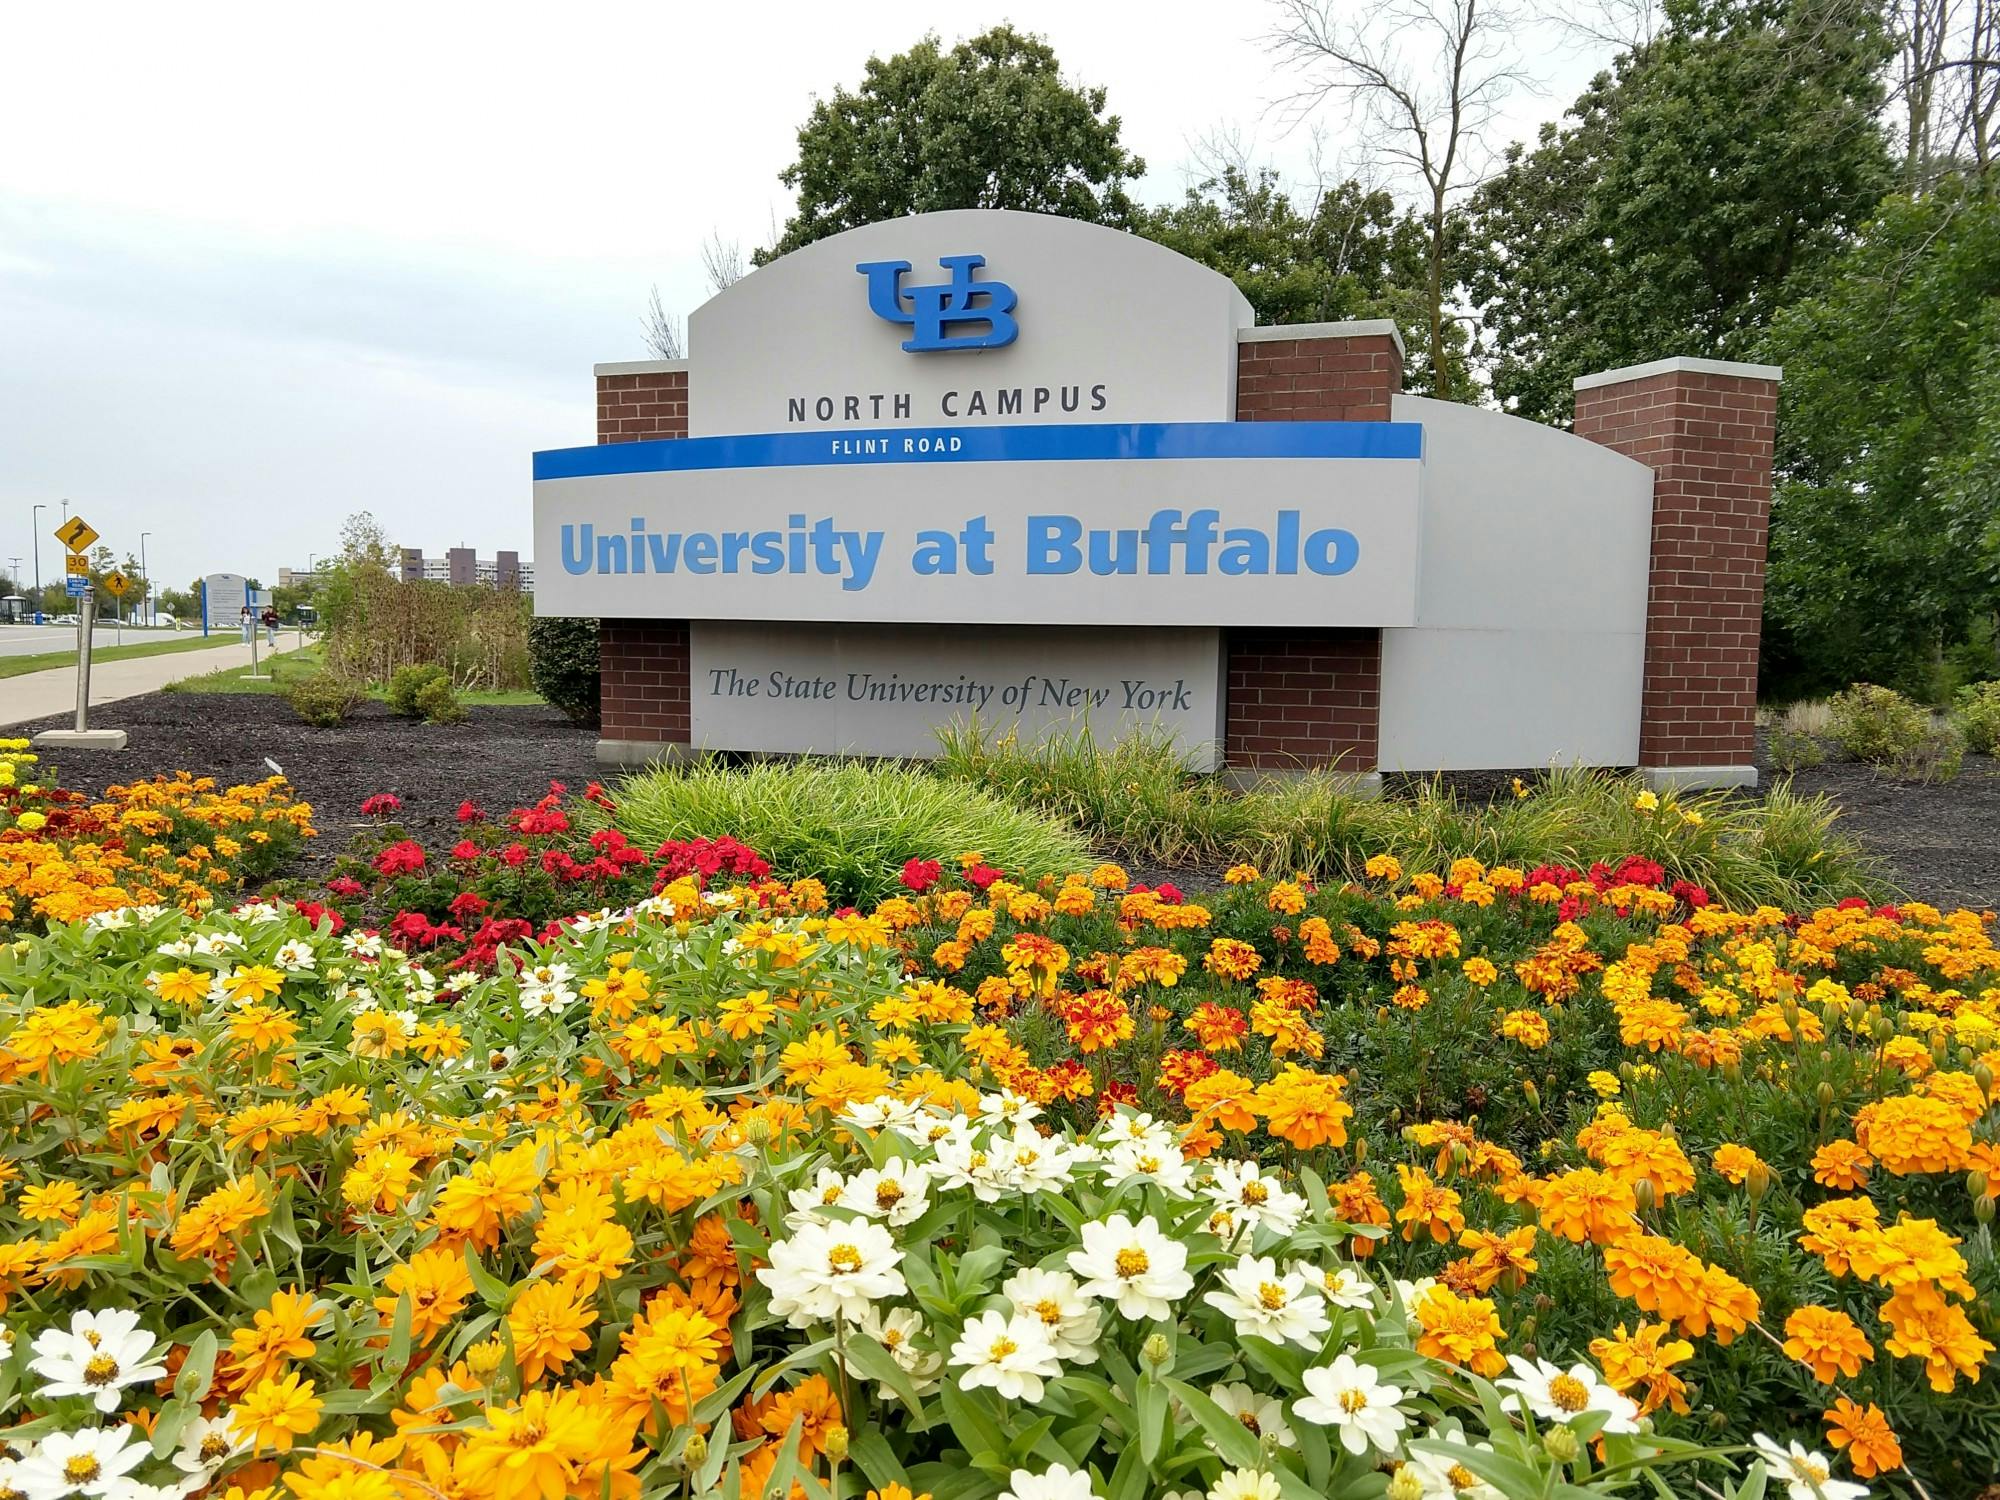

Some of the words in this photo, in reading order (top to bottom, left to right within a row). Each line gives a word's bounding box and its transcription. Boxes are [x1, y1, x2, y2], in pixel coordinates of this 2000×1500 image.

[856, 255, 1019, 353] UB
[788, 393, 911, 422] NORTH
[941, 384, 1107, 417] CAMPUS
[832, 440, 889, 455] FLINT
[904, 437, 962, 453] ROAD
[69, 557, 87, 567] 30
[561, 514, 885, 591] University
[912, 515, 995, 575] at
[1026, 509, 1360, 576] Buffalo
[709, 669, 760, 697] The
[767, 671, 837, 700] State
[846, 673, 994, 712] University
[1002, 676, 1036, 714] of
[1038, 678, 1110, 709] New
[1120, 679, 1192, 711] York
